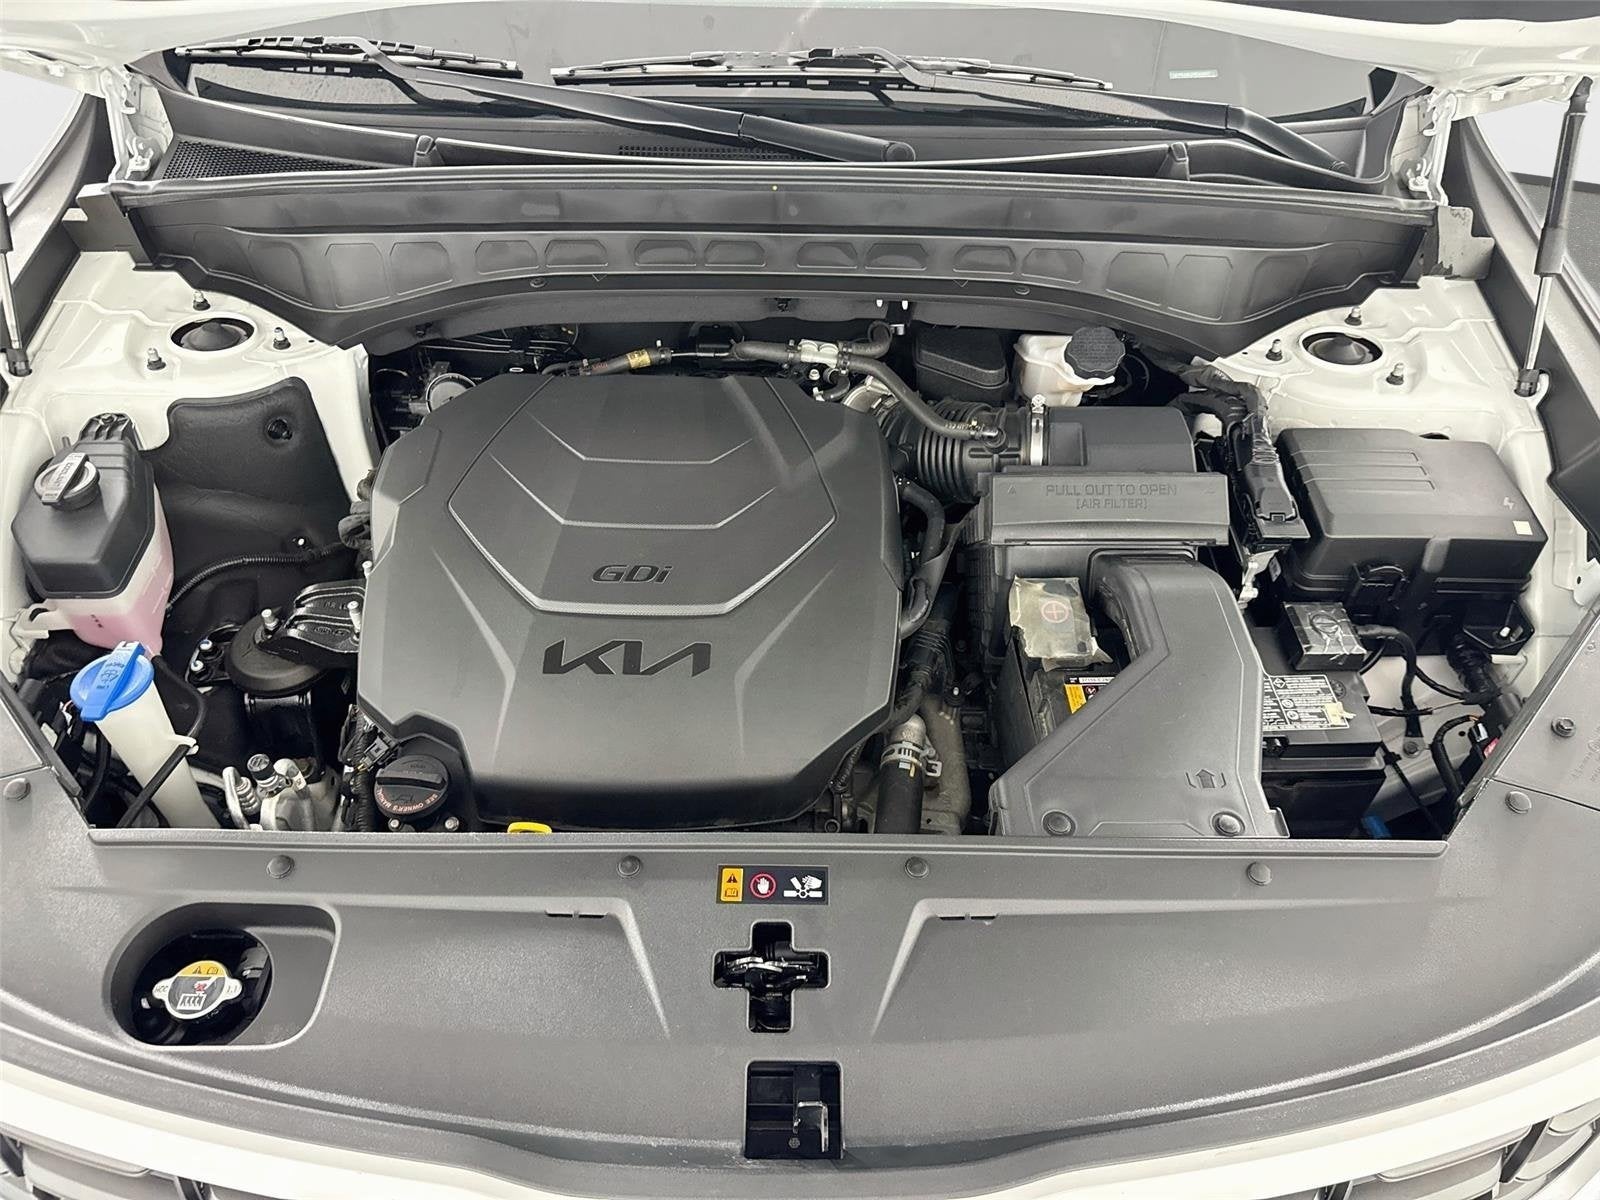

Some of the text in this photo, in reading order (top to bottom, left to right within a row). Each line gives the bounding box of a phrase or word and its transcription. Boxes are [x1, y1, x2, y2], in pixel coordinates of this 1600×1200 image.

[1046, 484, 1177, 496] PULL OUT TO OPEN
[592, 564, 674, 584] GDi
[542, 638, 712, 678] KIA
[425, 793, 438, 805] SEE
[392, 802, 424, 812] OWNER'S
